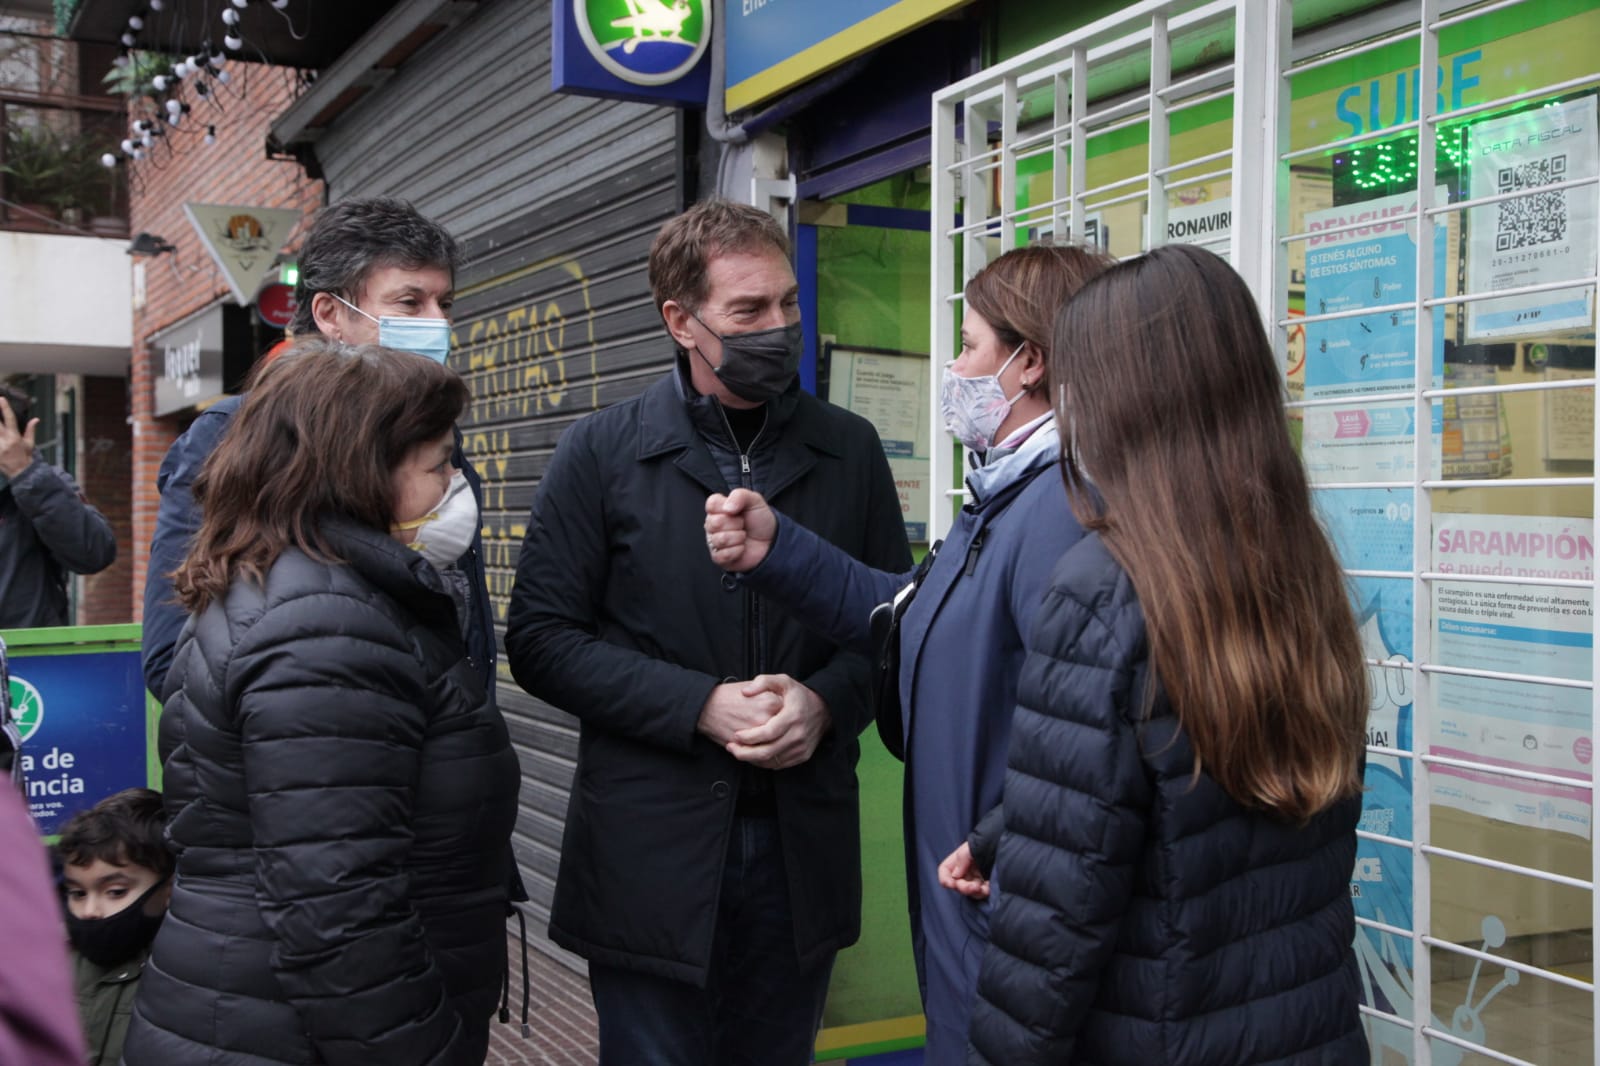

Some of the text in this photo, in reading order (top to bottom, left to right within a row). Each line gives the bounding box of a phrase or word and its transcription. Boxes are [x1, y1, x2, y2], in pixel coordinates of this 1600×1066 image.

[1482, 124, 1582, 155] DATA FISCAL
[1309, 204, 1405, 246] DENGUE
[1319, 250, 1344, 264] TENÉS
[1346, 244, 1382, 258] ALGUNO
[1322, 263, 1349, 276] ESTOS
[1350, 255, 1397, 272] SÍNTOMAS
[1497, 592, 1534, 602] enfermedad
[1551, 597, 1590, 607] altamente
[1497, 601, 1516, 609] forma
[1518, 603, 1526, 611] de
[1527, 605, 1560, 614] prevenirla
[42, 747, 75, 770] de
